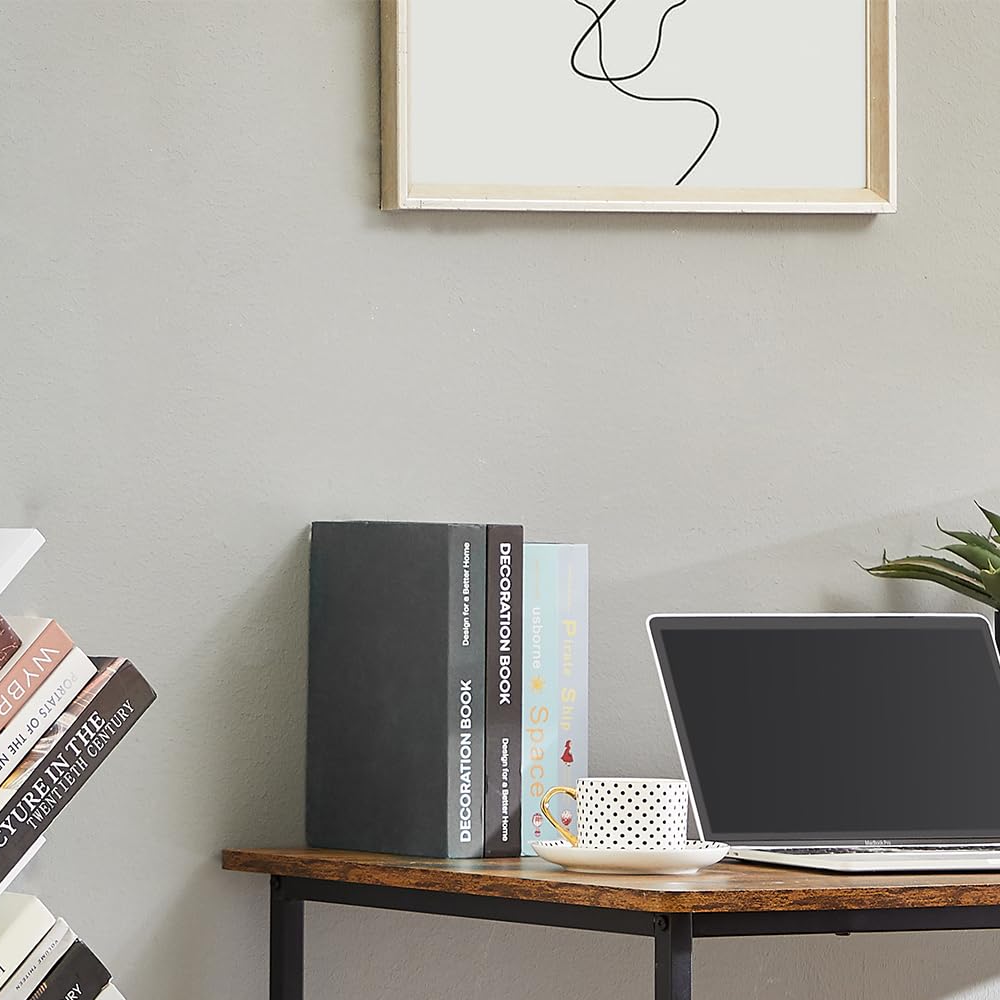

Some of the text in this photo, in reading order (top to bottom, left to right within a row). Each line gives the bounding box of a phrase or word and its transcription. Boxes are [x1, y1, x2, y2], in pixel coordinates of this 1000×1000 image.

[463, 542, 471, 568] Home
[463, 617, 471, 646] Design
[500, 543, 511, 705] DECORATION BOOK
[26, 717, 40, 735] OF
[526, 607, 549, 798] usborne Space
[7, 733, 28, 756] THE
[26, 699, 136, 830] TWENTIETH CENTURY
[45, 753, 70, 781] IN
[65, 711, 106, 757] THE
[460, 679, 473, 843] DECORATION BOOK
[501, 737, 509, 767] Design
